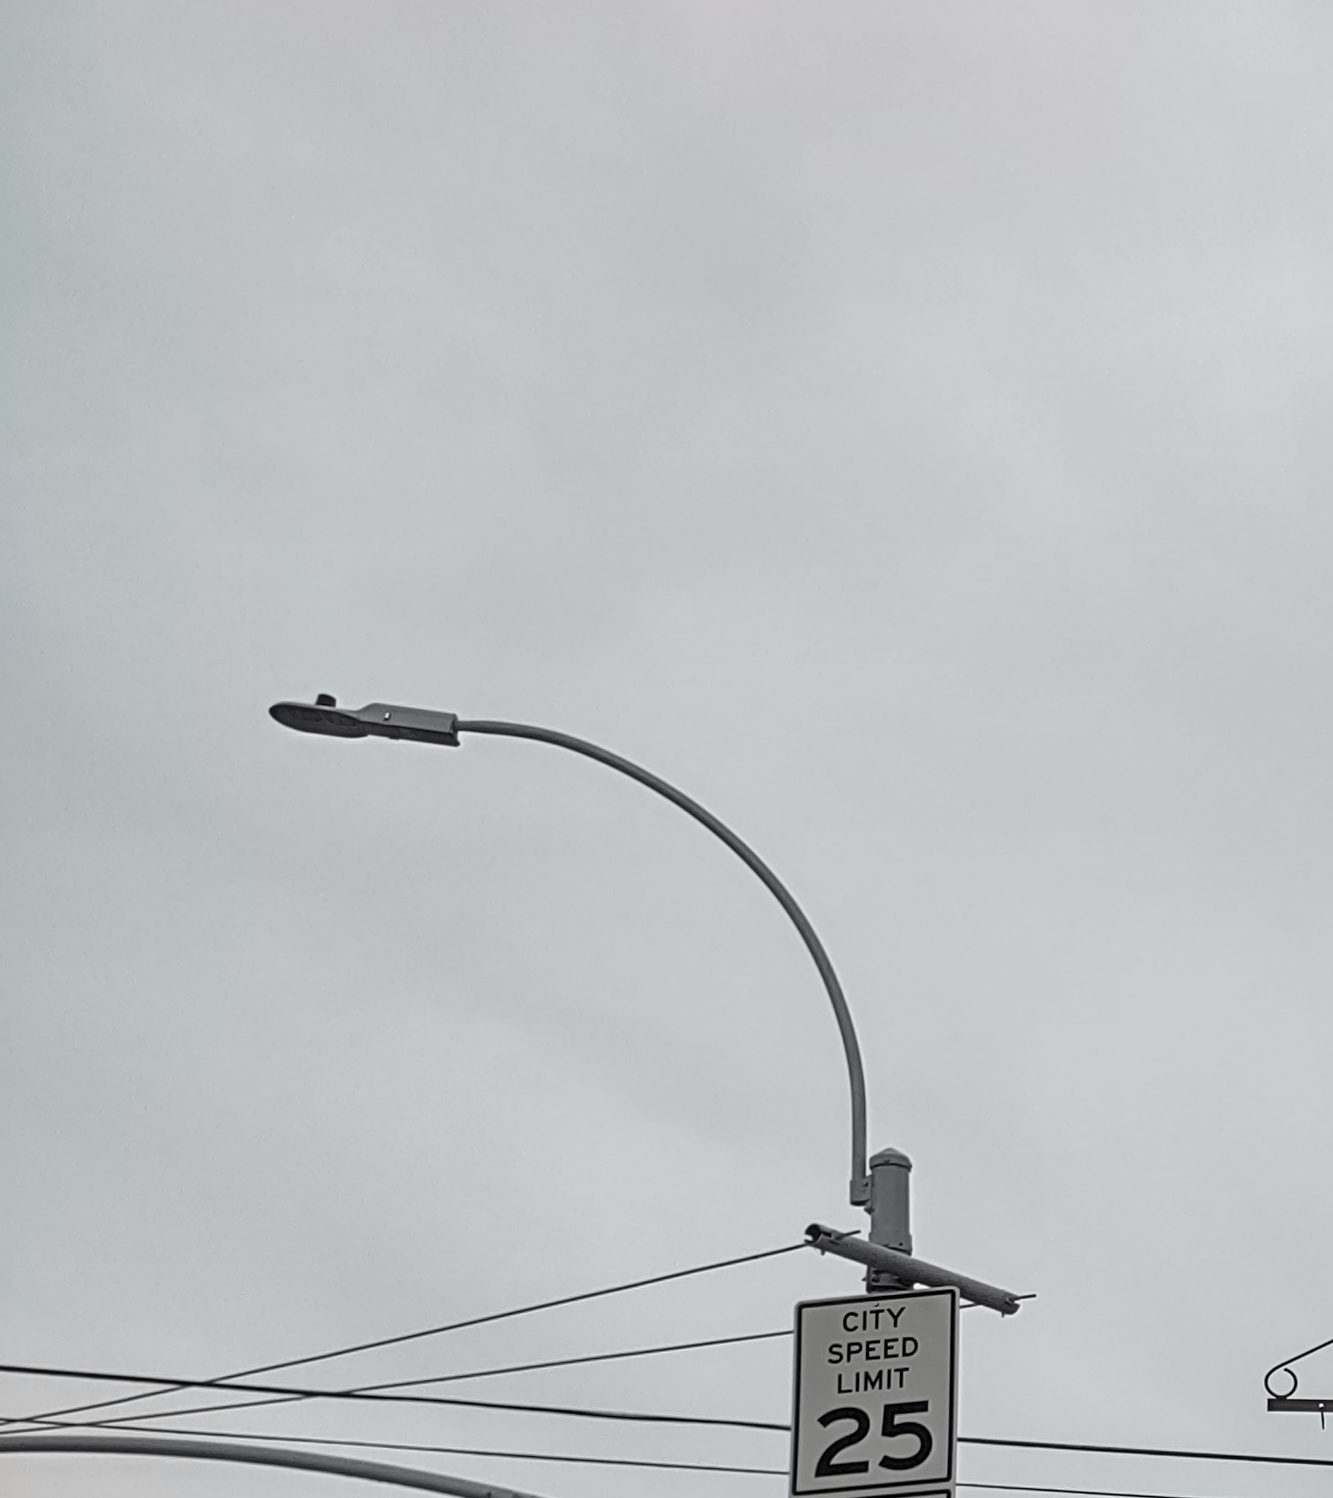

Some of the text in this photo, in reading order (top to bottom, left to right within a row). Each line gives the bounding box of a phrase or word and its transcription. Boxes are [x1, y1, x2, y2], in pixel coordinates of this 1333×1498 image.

[842, 1306, 906, 1332] CITY
[827, 1337, 919, 1364] SPEED
[837, 1367, 909, 1394] LIMIT
[814, 1400, 933, 1478] 25
